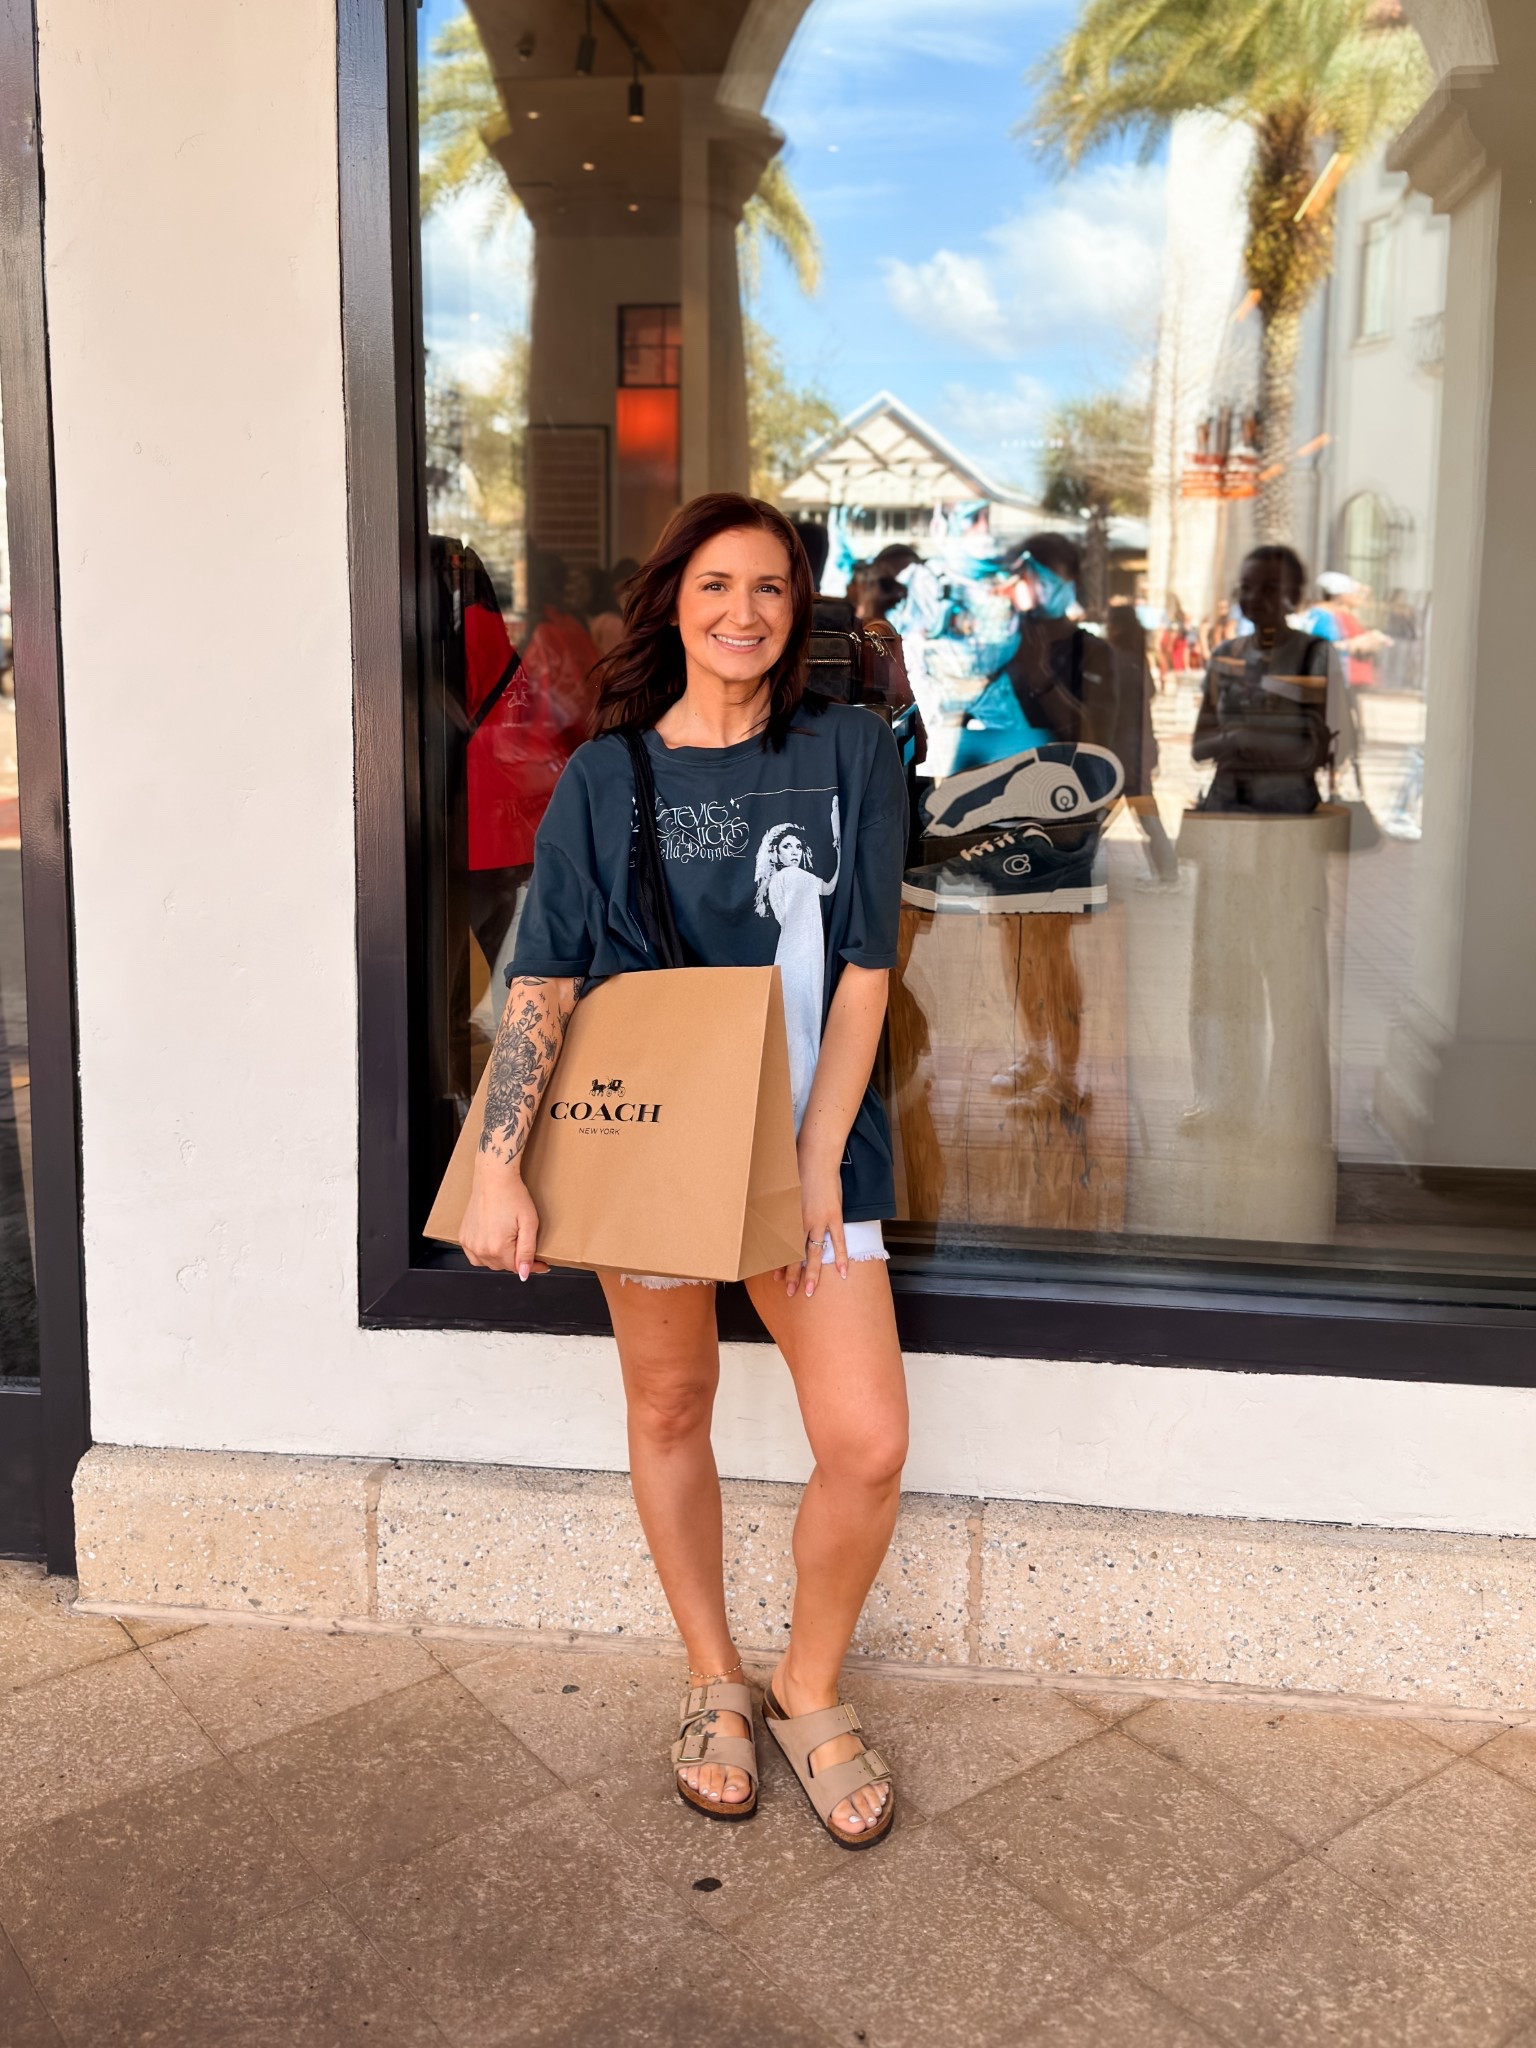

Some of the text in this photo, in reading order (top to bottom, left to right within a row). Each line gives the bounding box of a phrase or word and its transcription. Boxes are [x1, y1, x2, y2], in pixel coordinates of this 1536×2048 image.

[550, 1102, 662, 1122] COACH
[578, 1127, 621, 1136] NEW YORK
